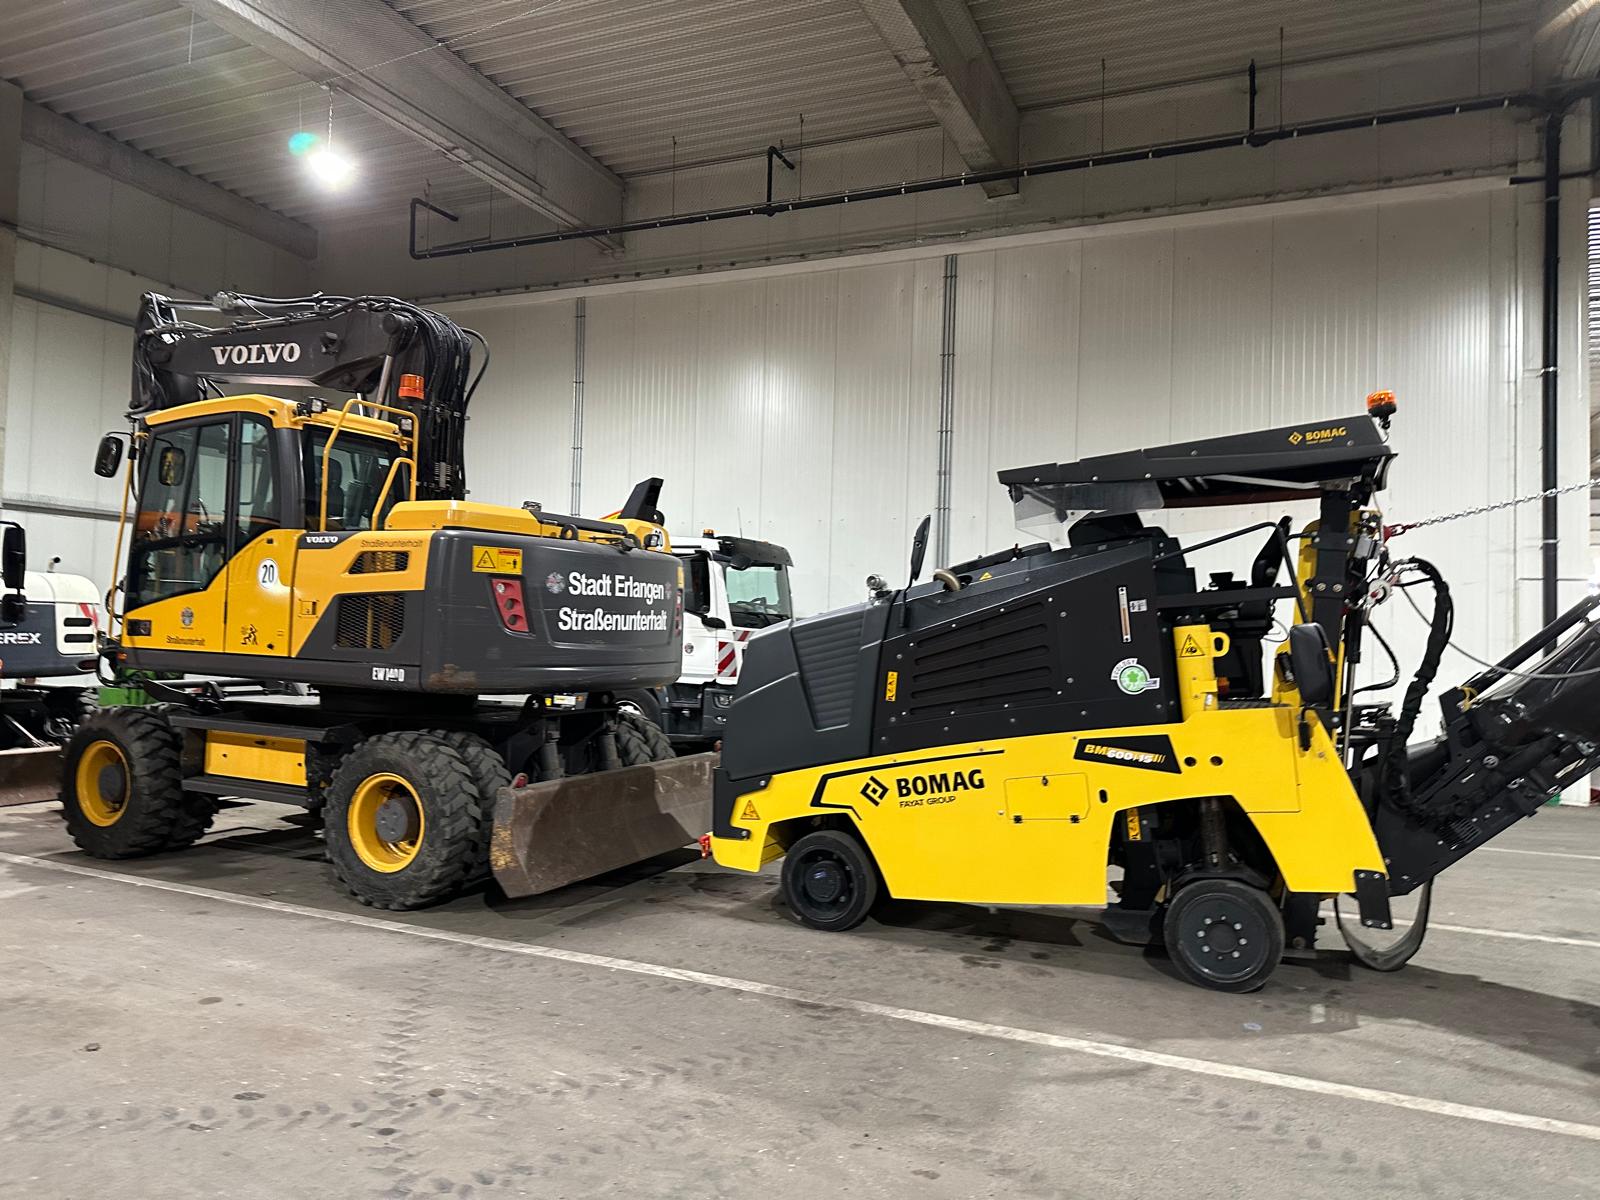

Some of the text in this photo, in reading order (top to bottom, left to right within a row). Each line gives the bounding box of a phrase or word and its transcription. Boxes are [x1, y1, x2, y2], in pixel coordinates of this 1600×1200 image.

[211, 342, 301, 365] VOLVO
[1305, 426, 1347, 440] BOMAG
[305, 536, 339, 544] VOLVO
[262, 564, 275, 584] 20
[568, 571, 665, 605] Stadt Erlangen
[558, 606, 668, 631] Straßenunterhalt
[896, 769, 985, 798] BOMAG
[899, 795, 956, 809] FAYAT GROUP
